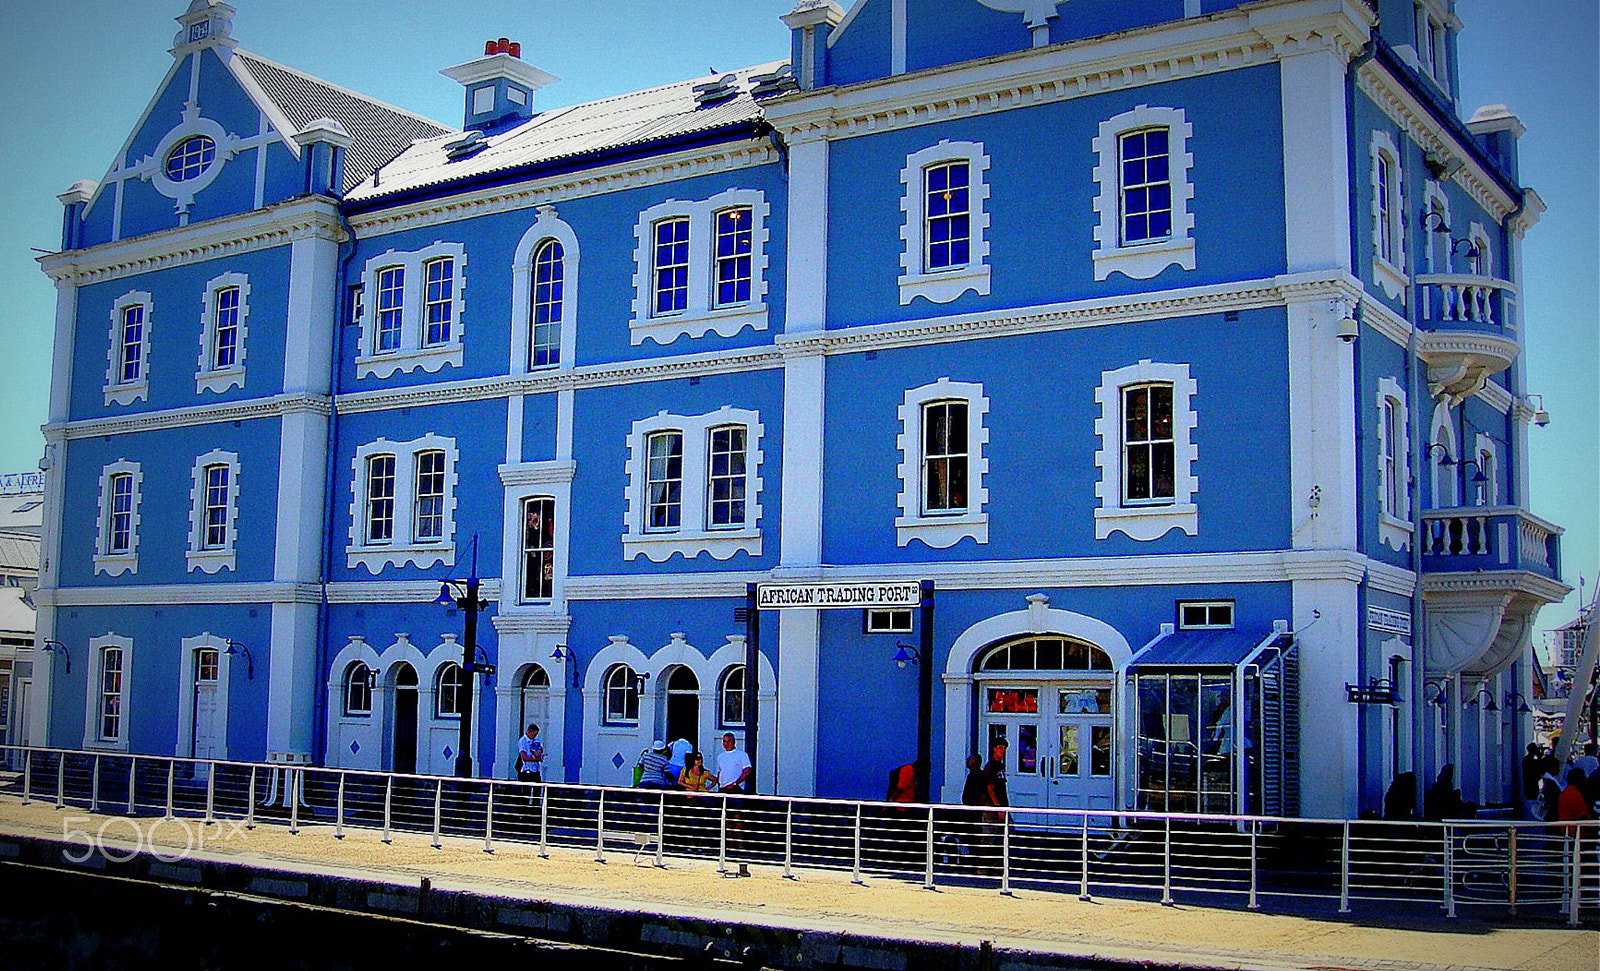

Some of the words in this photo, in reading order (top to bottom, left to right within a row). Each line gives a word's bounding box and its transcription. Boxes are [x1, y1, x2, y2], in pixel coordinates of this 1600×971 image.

[5, 478, 12, 487] &
[761, 588, 814, 604] AFRICAN
[817, 587, 876, 603] TRADING
